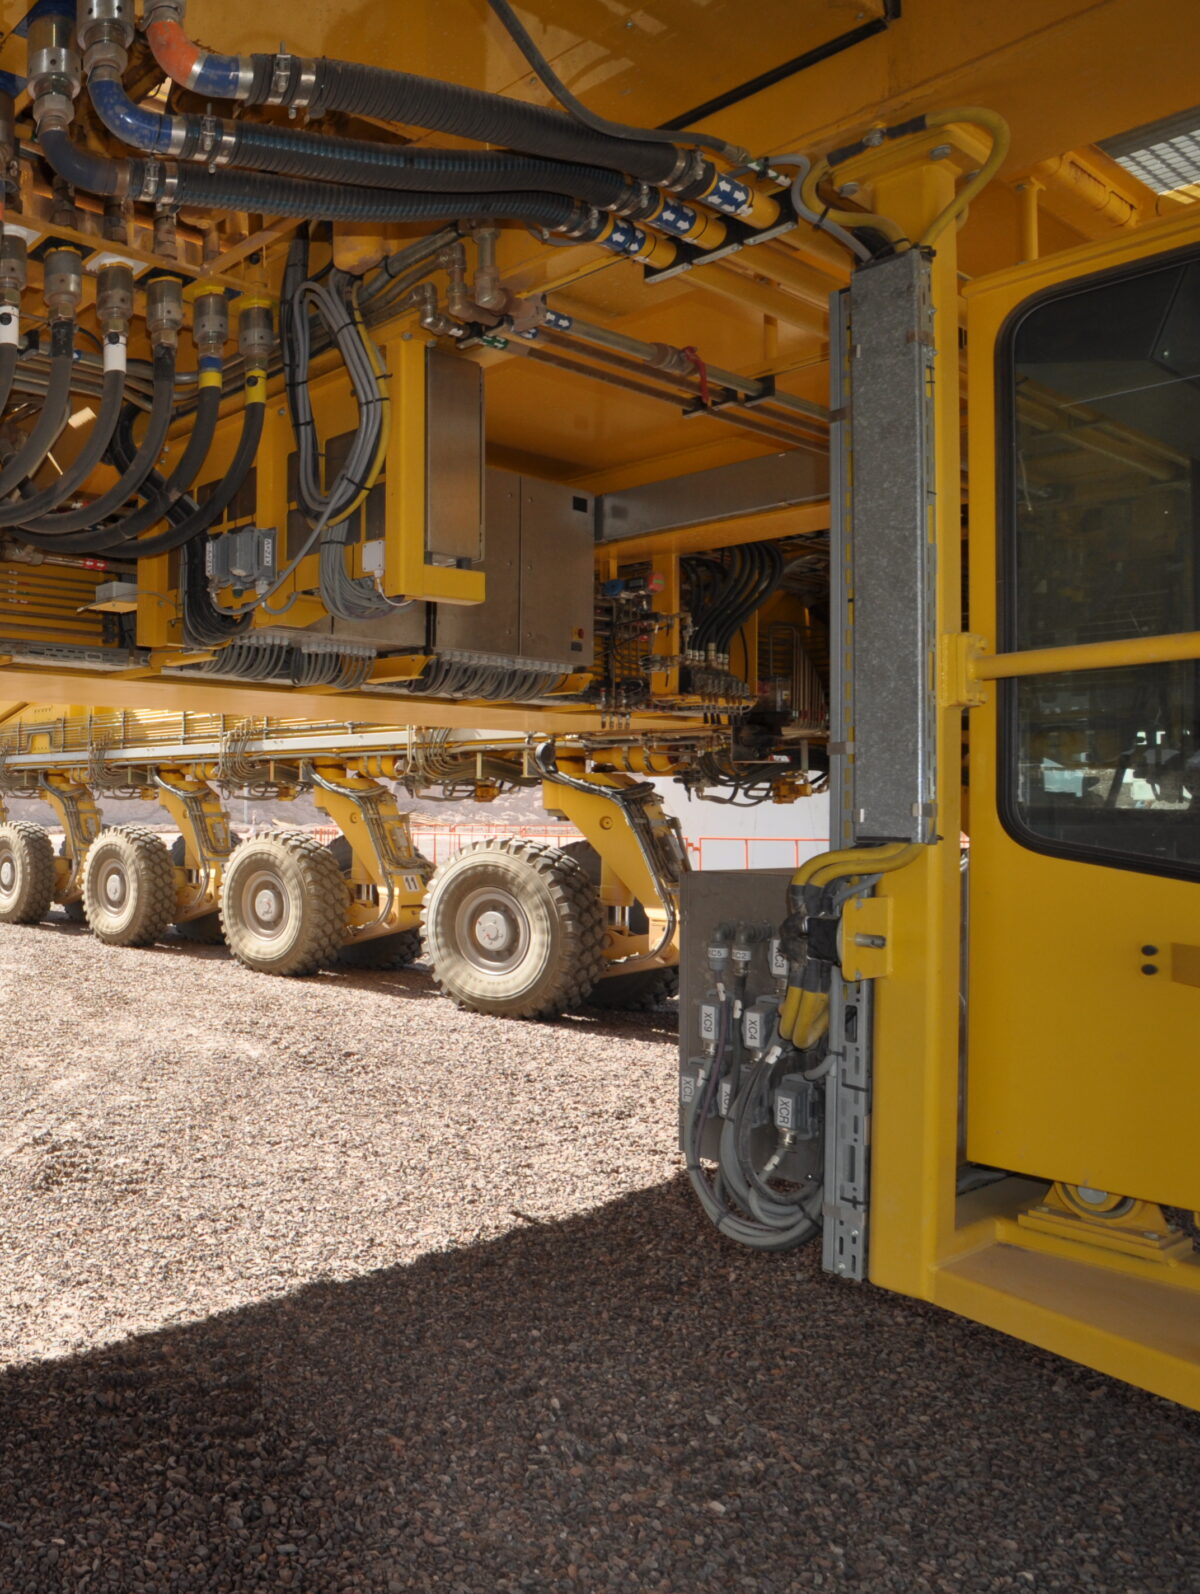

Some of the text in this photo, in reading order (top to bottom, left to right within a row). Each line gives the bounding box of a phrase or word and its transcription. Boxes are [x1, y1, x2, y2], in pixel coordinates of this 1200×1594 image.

[405, 876, 418, 890] 11
[708, 949, 721, 957] C5
[733, 951, 747, 959] C2
[703, 1012, 713, 1033] XC9
[748, 1019, 758, 1040] XC4
[683, 1079, 693, 1099] XCL
[778, 1099, 792, 1124] XCR
